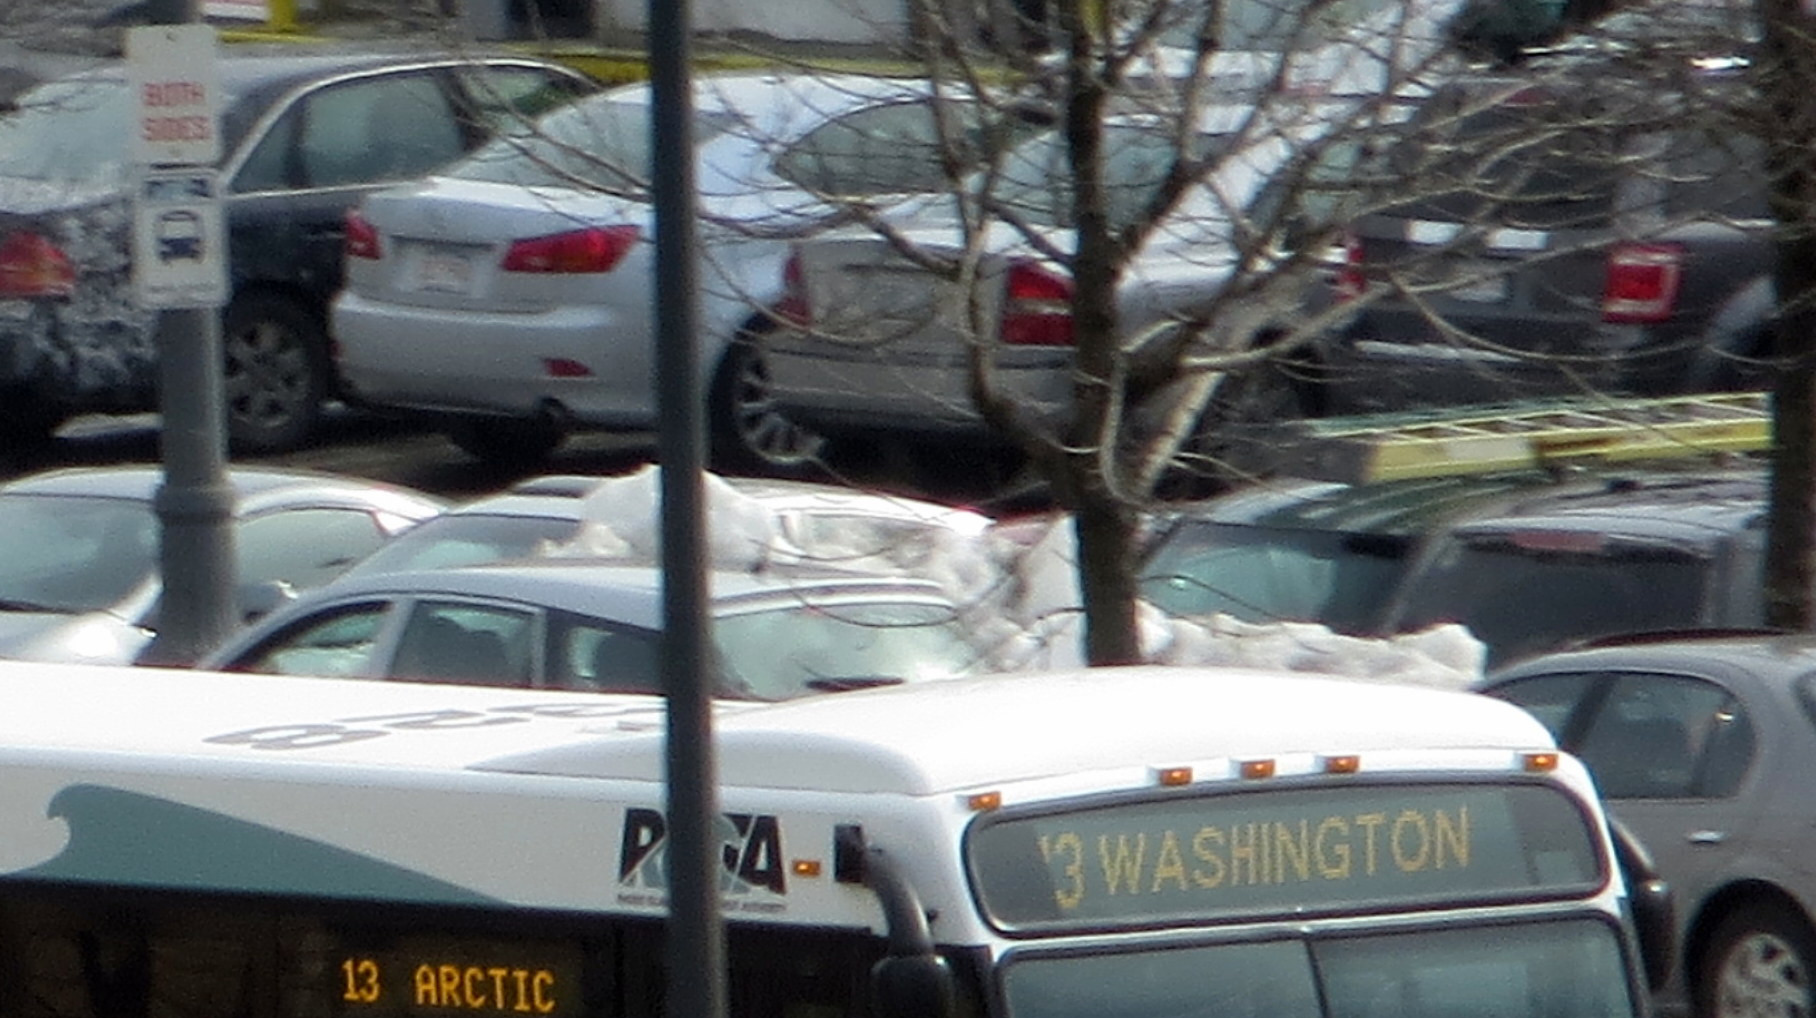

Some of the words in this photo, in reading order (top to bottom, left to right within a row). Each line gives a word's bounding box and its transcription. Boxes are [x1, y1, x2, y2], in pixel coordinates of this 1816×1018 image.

[143, 82, 205, 106] BOTH
[141, 116, 210, 141] SIDES
[1097, 804, 1470, 895] WASHINGTON
[342, 958, 380, 1002] 13
[415, 963, 555, 1013] ARCTIC
